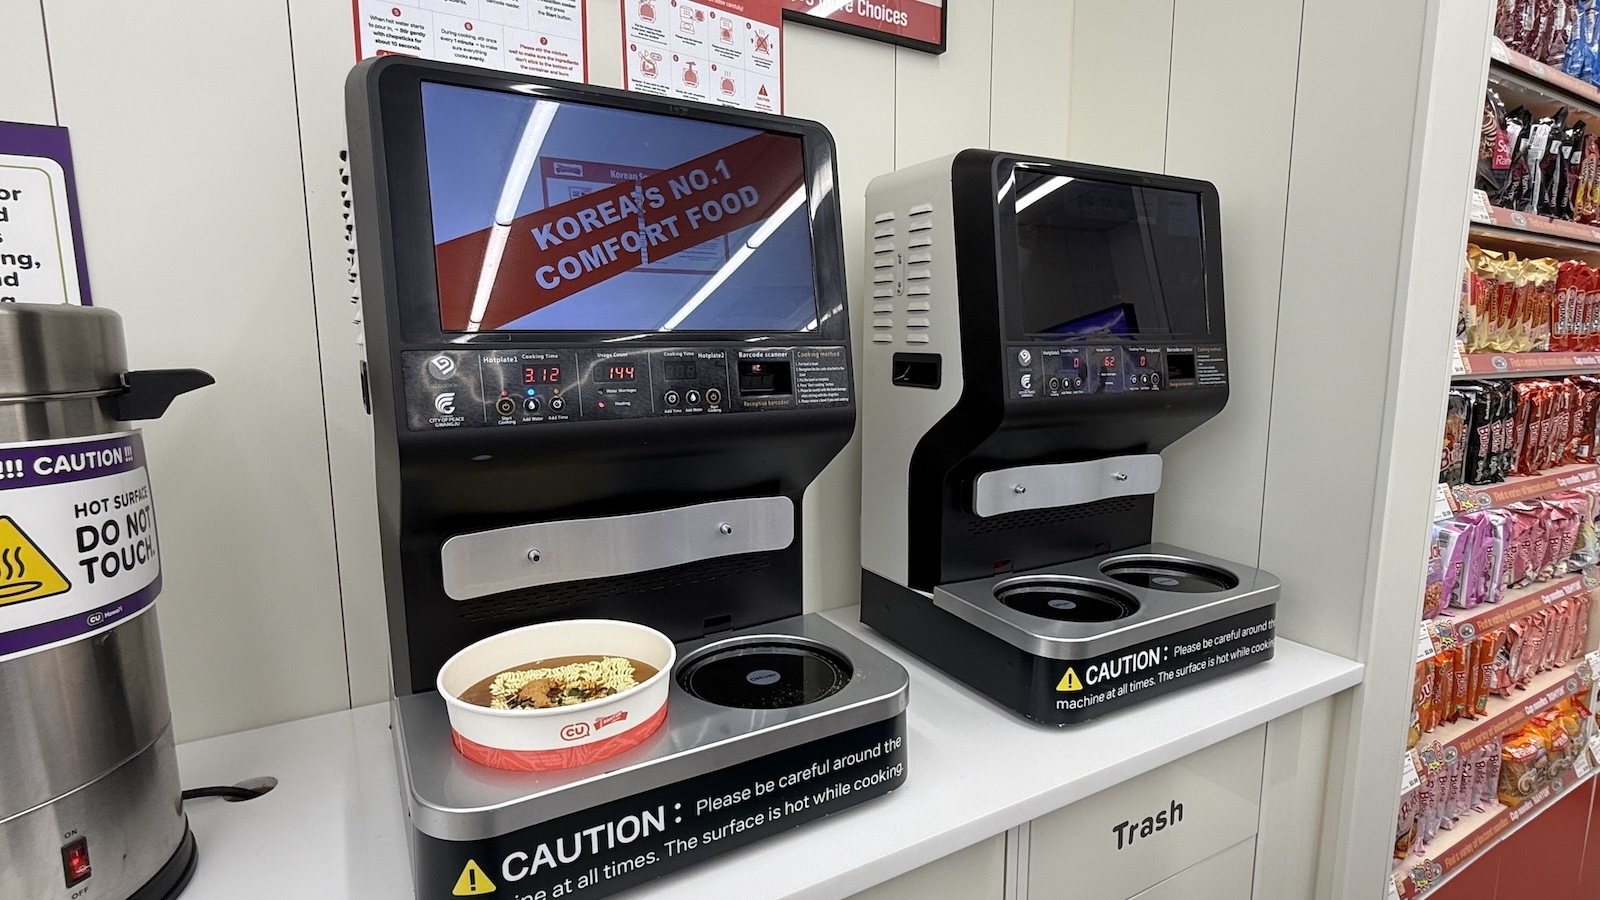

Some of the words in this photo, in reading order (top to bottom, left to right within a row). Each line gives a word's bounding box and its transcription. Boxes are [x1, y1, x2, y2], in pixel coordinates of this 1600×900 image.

[858, 0, 908, 26] Choices
[386, 33, 414, 42] chopsticks
[441, 28, 457, 36] During
[463, 48, 488, 56] everything
[555, 58, 578, 66] ingredients
[531, 187, 665, 250] KOREA'S
[668, 159, 731, 200] NO.1
[535, 215, 680, 290] COMFORT
[686, 185, 760, 230] FOOD
[483, 356, 518, 364] Hotplate1
[698, 352, 724, 360] Hotplate2
[609, 367, 635, 380] 144
[33, 447, 123, 476] CAUTION
[74, 498, 108, 518] HOT
[114, 486, 148, 510] SURFACE
[76, 519, 120, 553] DO
[127, 505, 152, 539] NOT
[1086, 646, 1160, 686] CAUTION
[1174, 641, 1202, 658] Please
[1203, 636, 1214, 648] be
[1214, 628, 1241, 646] careful
[1242, 622, 1267, 638] around
[1056, 690, 1104, 710] machine
[1106, 688, 1116, 700] at
[1116, 684, 1128, 697] all
[1129, 676, 1156, 693] times.
[1158, 668, 1174, 683] The
[1176, 660, 1206, 678] surface
[1208, 658, 1214, 668] is
[1216, 652, 1230, 664] hot
[1230, 645, 1250, 661] while
[565, 725, 584, 738] CU
[502, 805, 666, 882] CAUTION
[696, 787, 751, 816] Please
[755, 780, 774, 796] be
[778, 759, 830, 788] careful
[834, 742, 880, 771] around
[884, 736, 902, 753] the
[64, 828, 78, 838] ON
[552, 878, 572, 897] at
[578, 867, 599, 889] all
[603, 852, 660, 880] times.
[664, 836, 698, 857] The
[702, 812, 764, 844] surface
[768, 806, 782, 822] is
[784, 796, 810, 816] hot
[812, 783, 851, 805] while
[854, 762, 904, 792] cooking.
[1112, 800, 1184, 850] Trash
[72, 886, 88, 900] OFF
